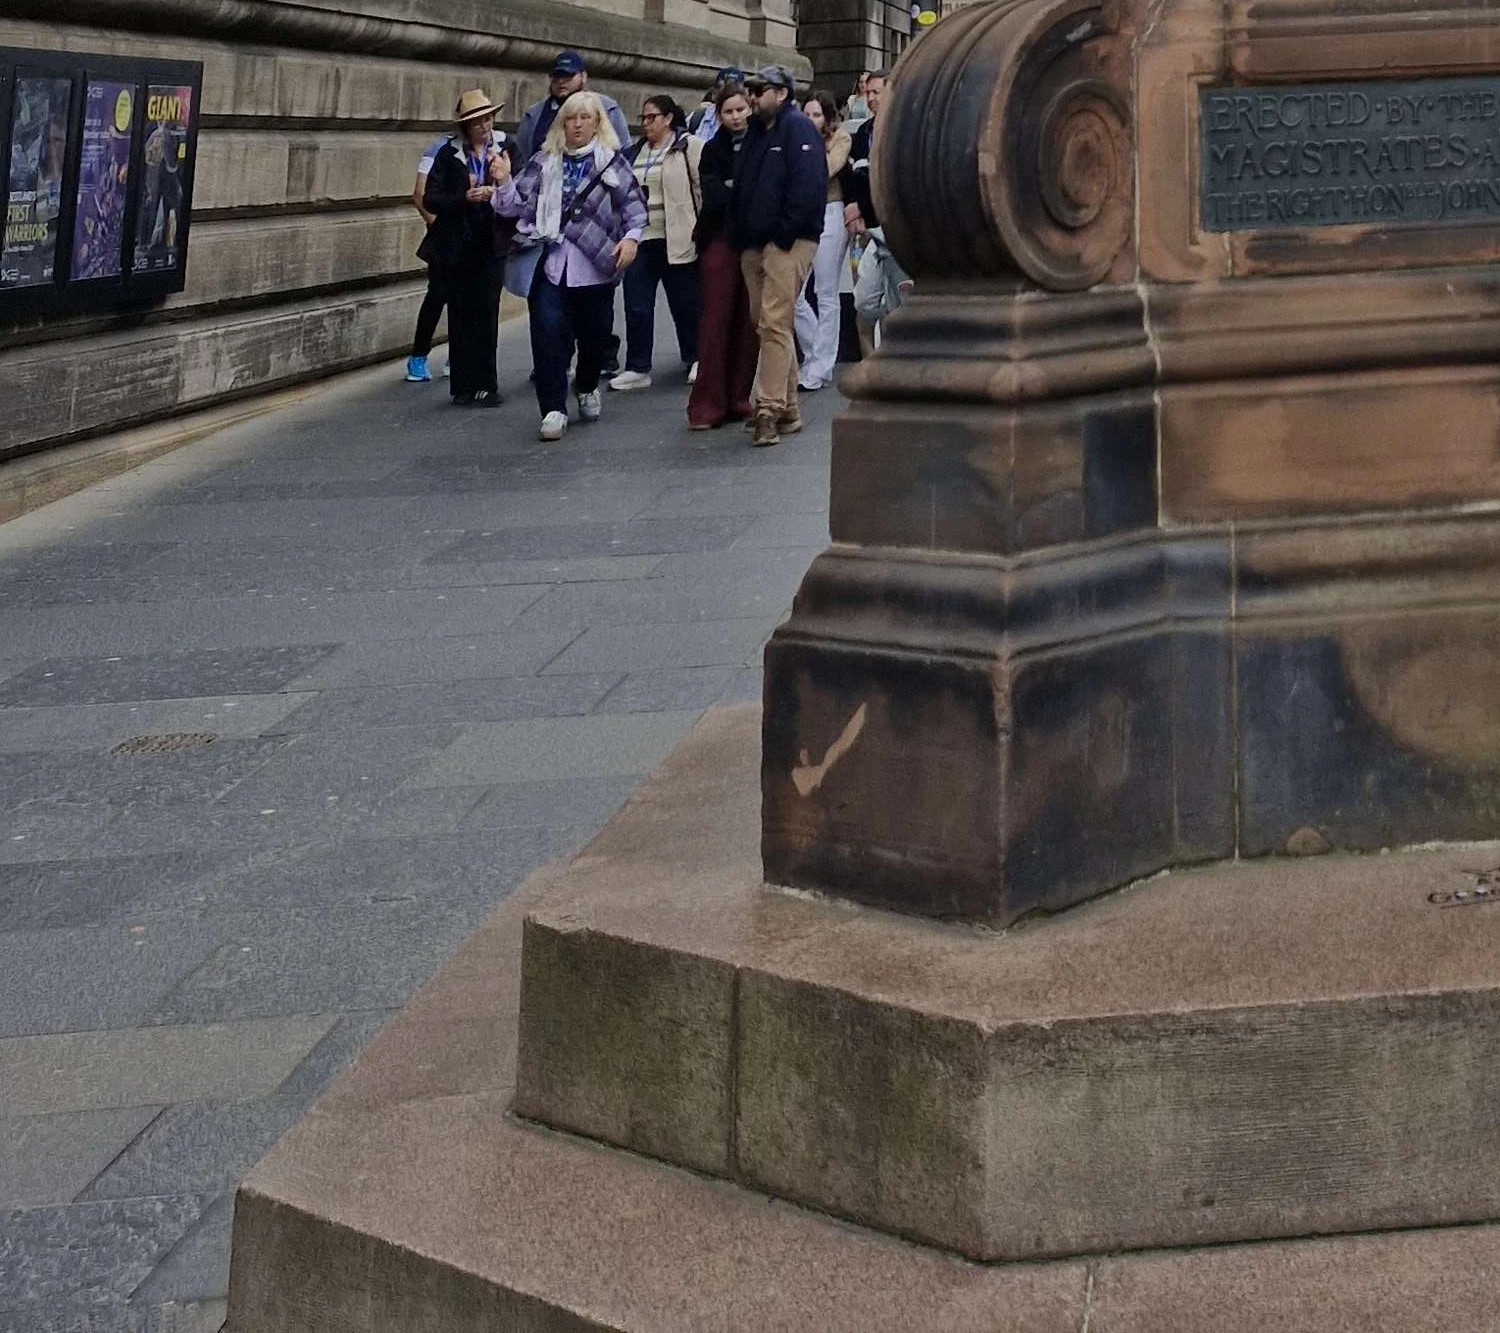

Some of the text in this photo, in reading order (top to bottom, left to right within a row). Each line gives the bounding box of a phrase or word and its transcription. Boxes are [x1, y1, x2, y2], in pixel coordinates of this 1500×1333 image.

[1210, 91, 1372, 139] ERECTED
[1384, 96, 1427, 124] BY
[1436, 91, 1496, 121] THE
[1209, 133, 1470, 181] MAGISTRATES
[1208, 192, 1264, 223] THE
[1266, 187, 1346, 225] RIGHT
